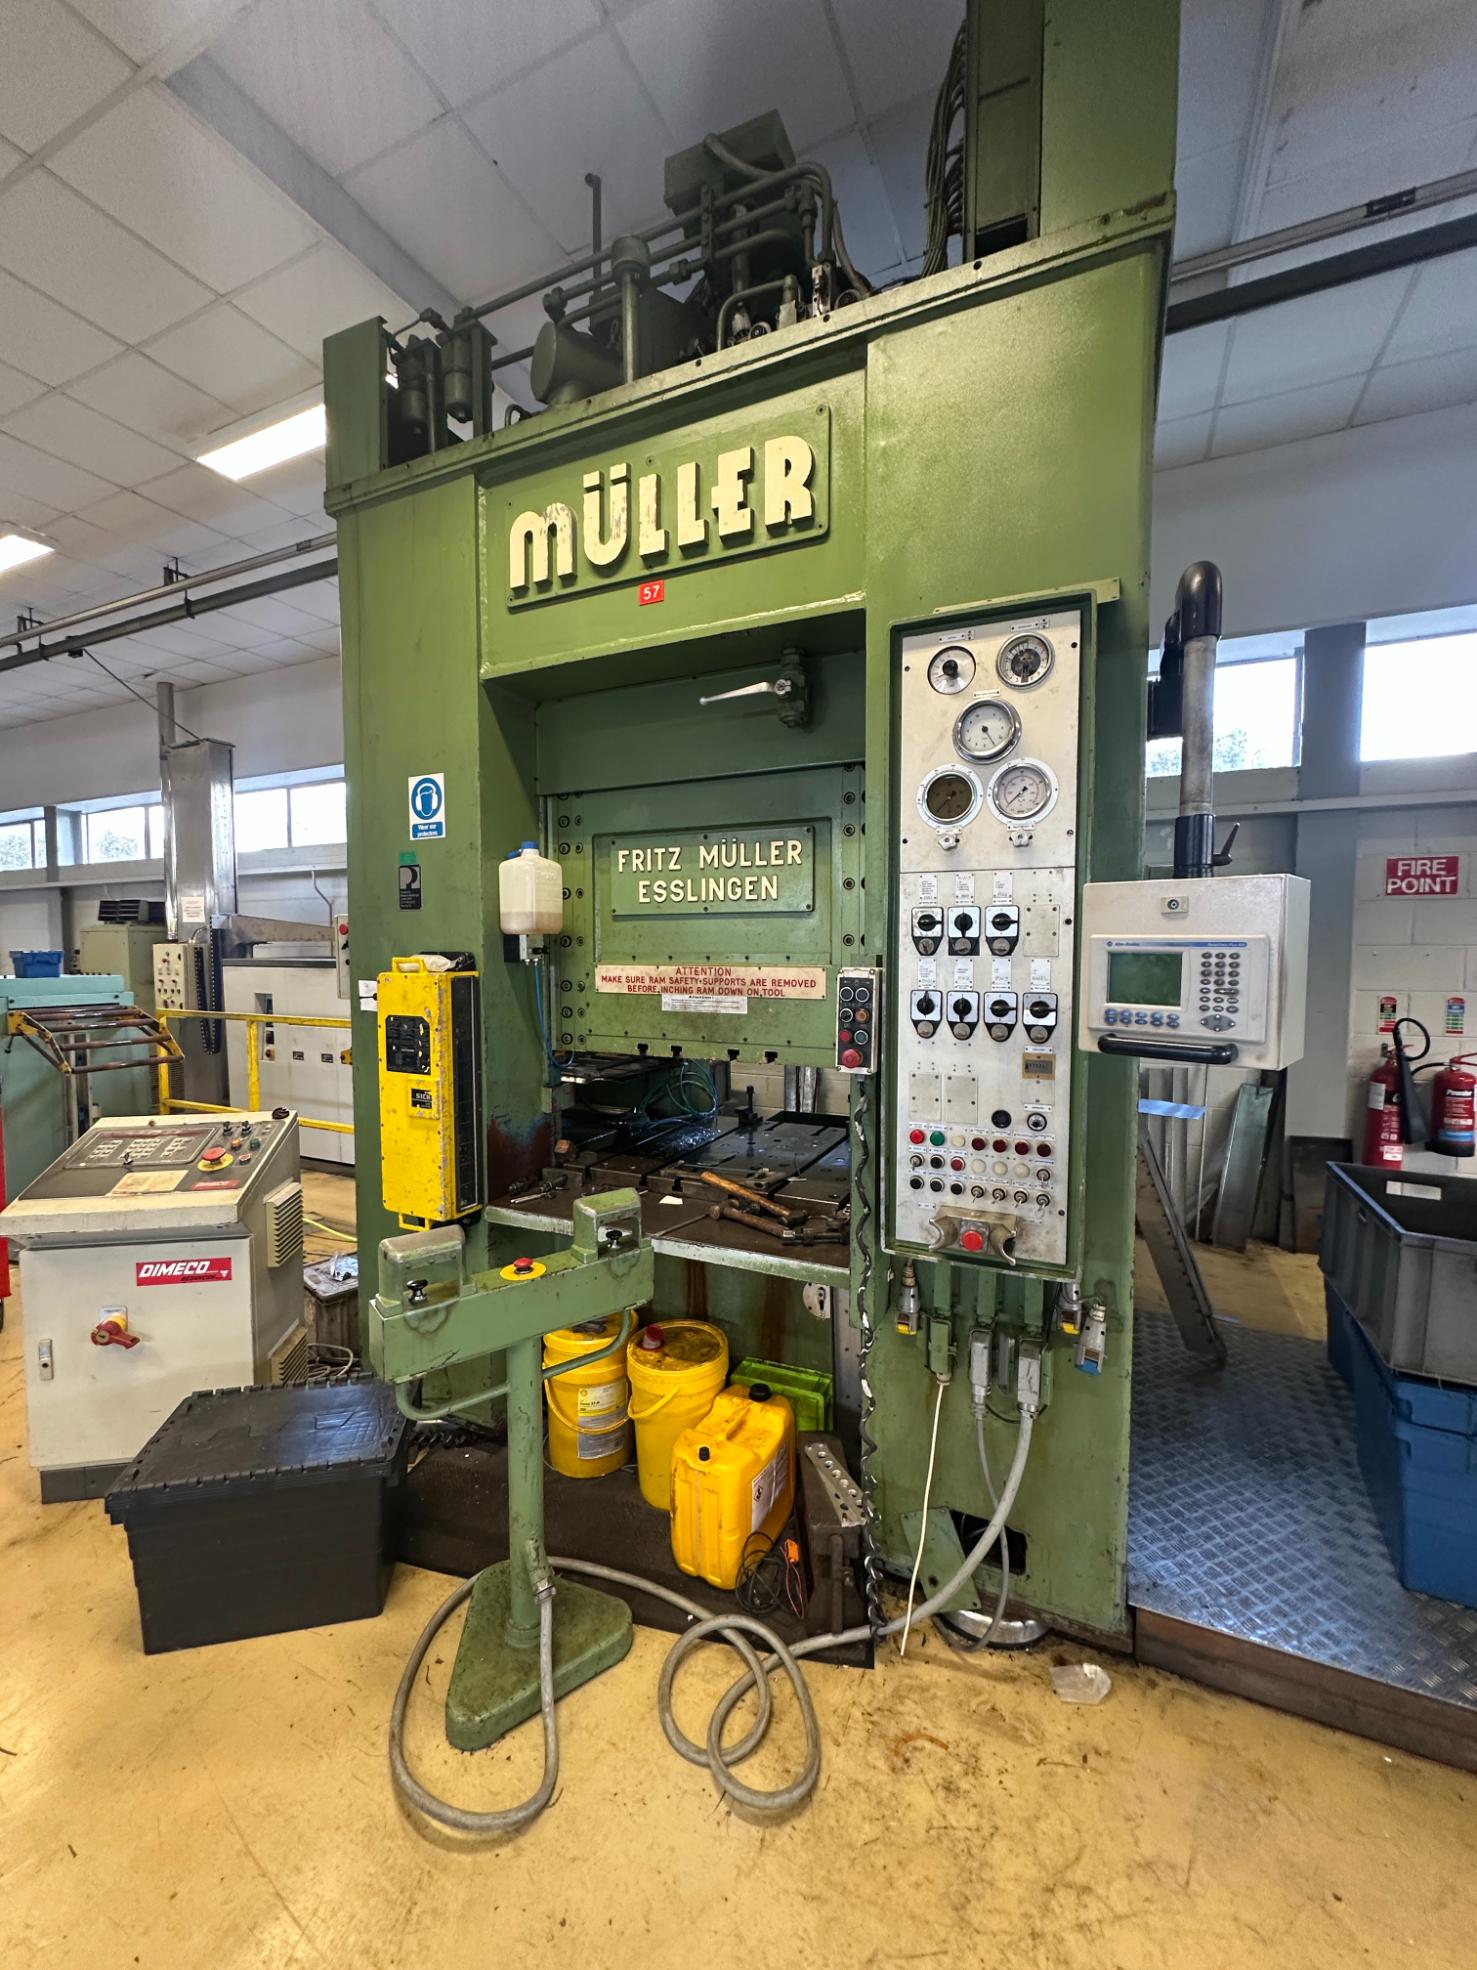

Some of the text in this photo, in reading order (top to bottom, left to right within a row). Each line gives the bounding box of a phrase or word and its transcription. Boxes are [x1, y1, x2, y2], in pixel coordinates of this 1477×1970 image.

[509, 435, 814, 590] MÜLLER
[643, 585, 660, 600] 57
[618, 838, 802, 873] FRITZ MÜLLER
[1397, 859, 1447, 876] FIRE
[638, 875, 778, 903] ESSLINGEN
[1387, 876, 1457, 894] POINT
[675, 967, 732, 976] ATTENTION
[601, 975, 622, 983] MAKE
[625, 976, 645, 984] SURE
[649, 976, 666, 984] RAM
[749, 978, 767, 987] ARE
[771, 979, 817, 988] REMOVED
[627, 985, 785, 997] BEFORE INCHING RAM DOWN ON TOOL
[138, 1260, 211, 1278] DIMECO
